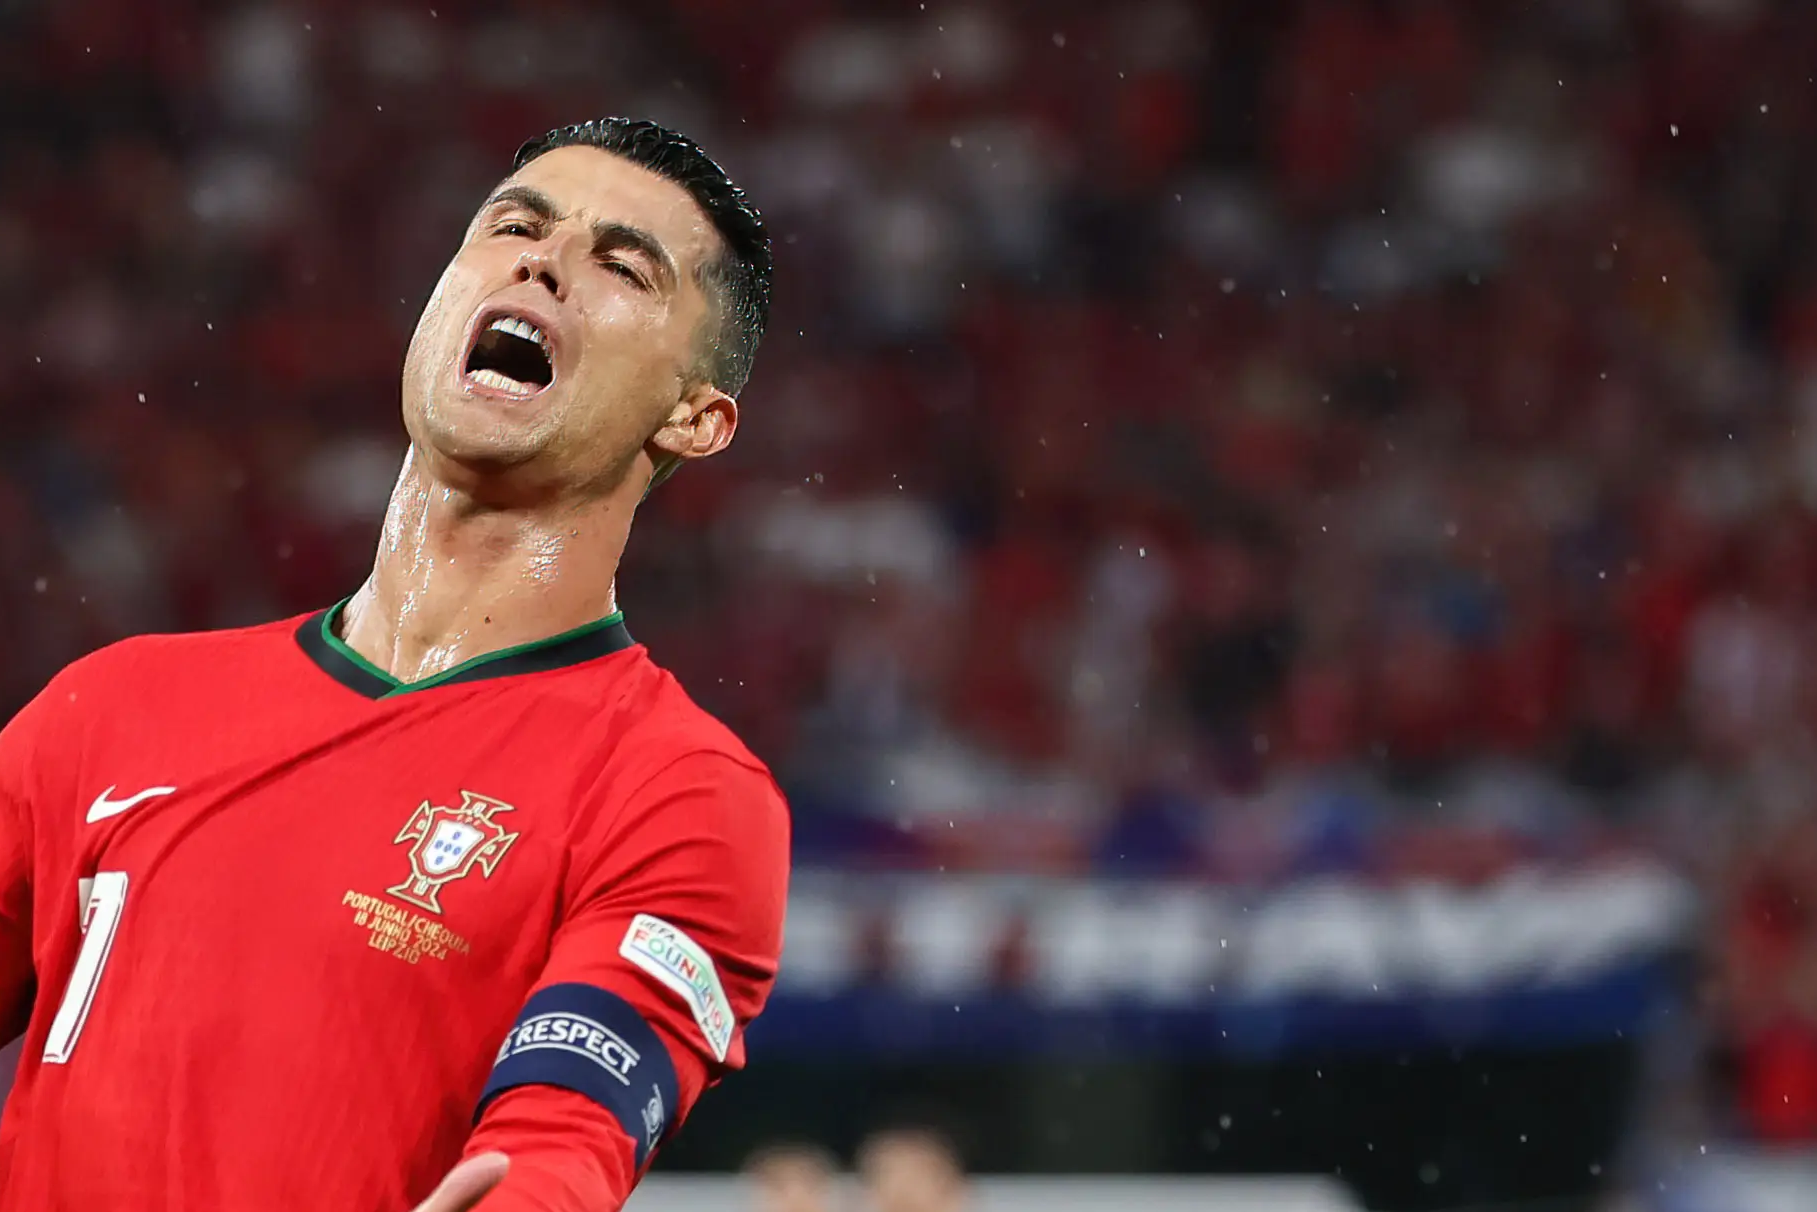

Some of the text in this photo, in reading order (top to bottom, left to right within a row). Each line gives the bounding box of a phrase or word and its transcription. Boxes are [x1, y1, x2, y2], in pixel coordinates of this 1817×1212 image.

[354, 910, 448, 961] 18 JUNHO 2024
[368, 931, 421, 965] LEIPZIG
[42, 870, 128, 1063] 7
[515, 1018, 637, 1074] RESPECT
